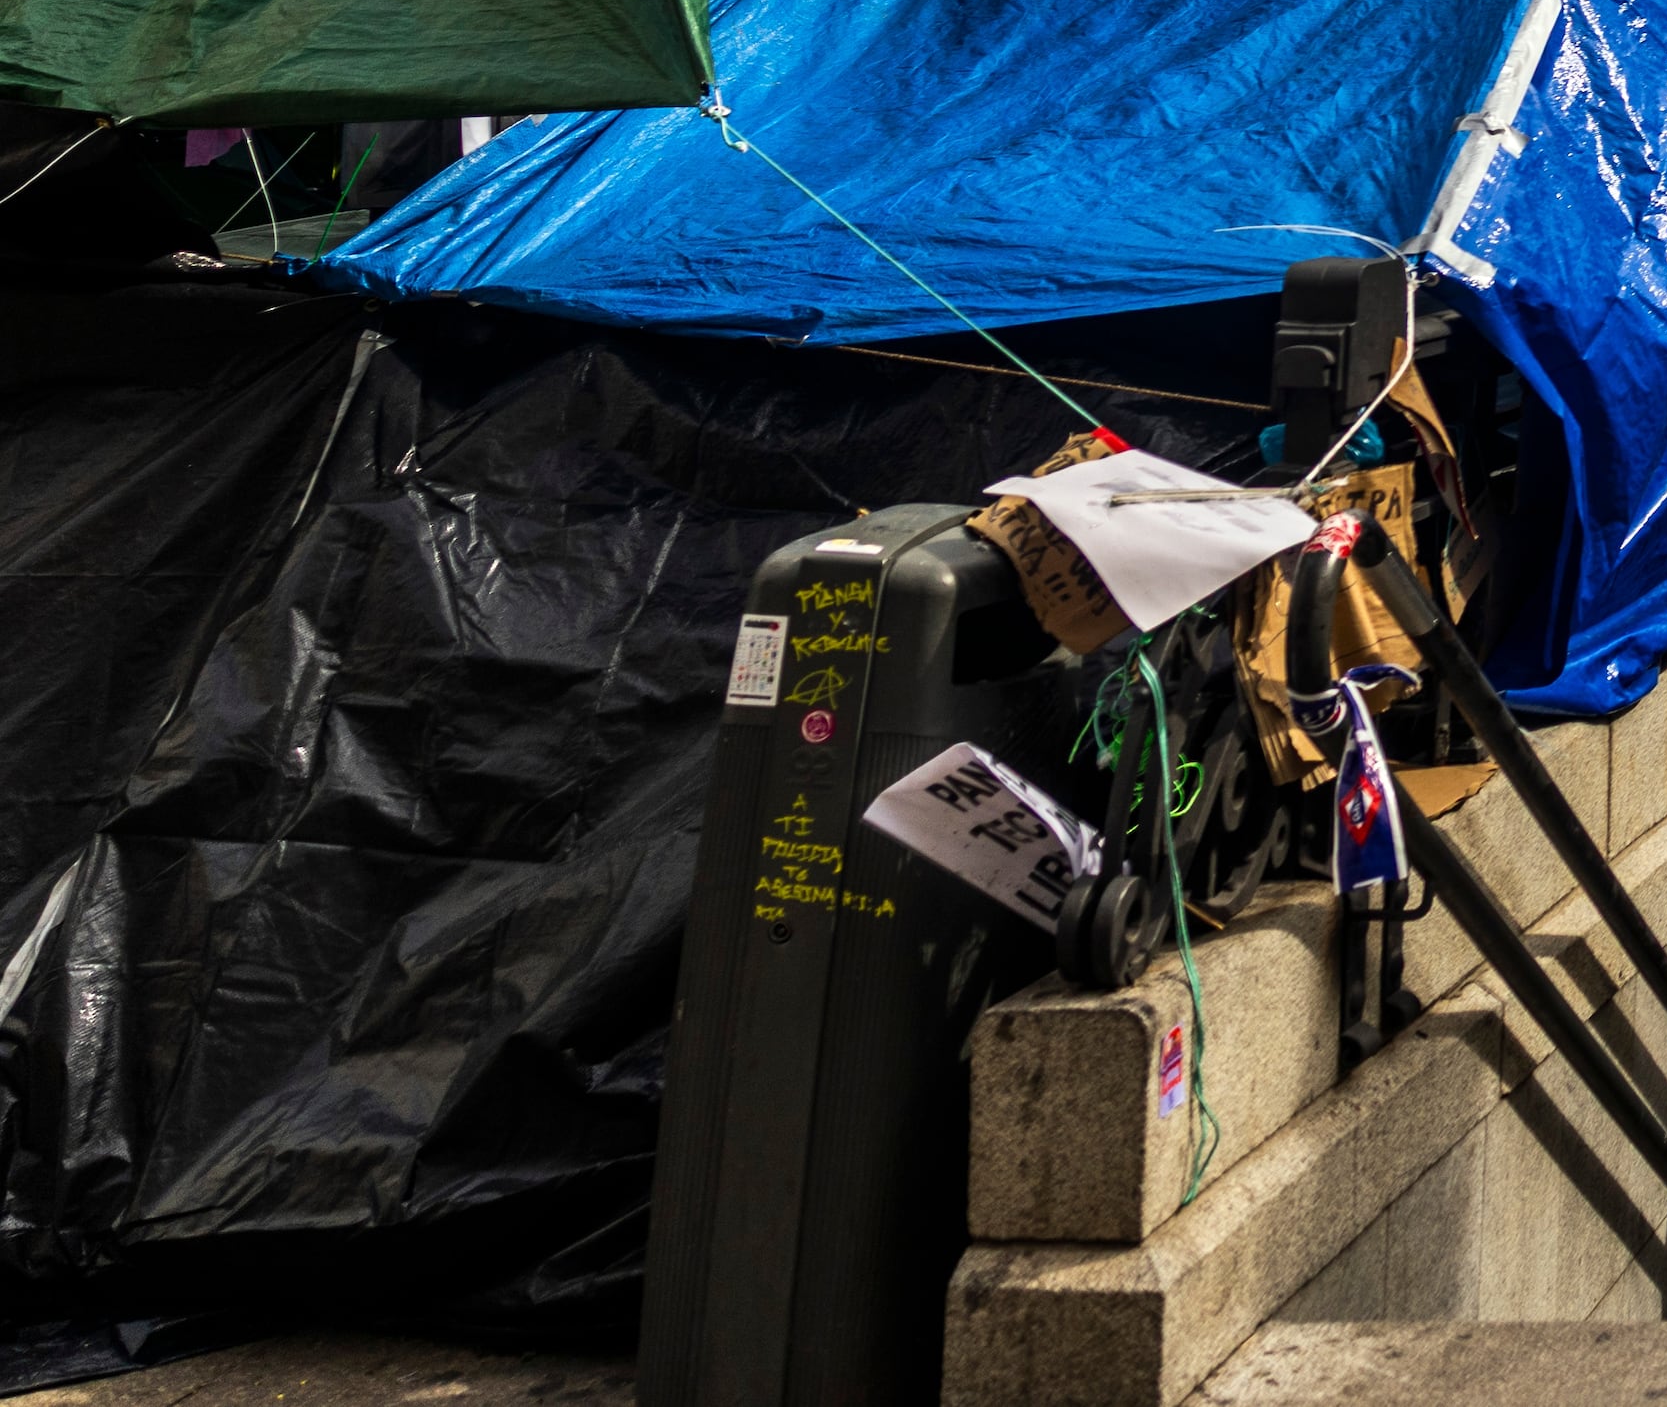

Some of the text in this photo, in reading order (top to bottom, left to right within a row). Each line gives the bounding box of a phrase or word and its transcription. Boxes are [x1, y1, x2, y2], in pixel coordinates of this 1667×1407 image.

[828, 611, 846, 632] Y
[792, 793, 807, 811] A
[774, 815, 815, 837] TI
